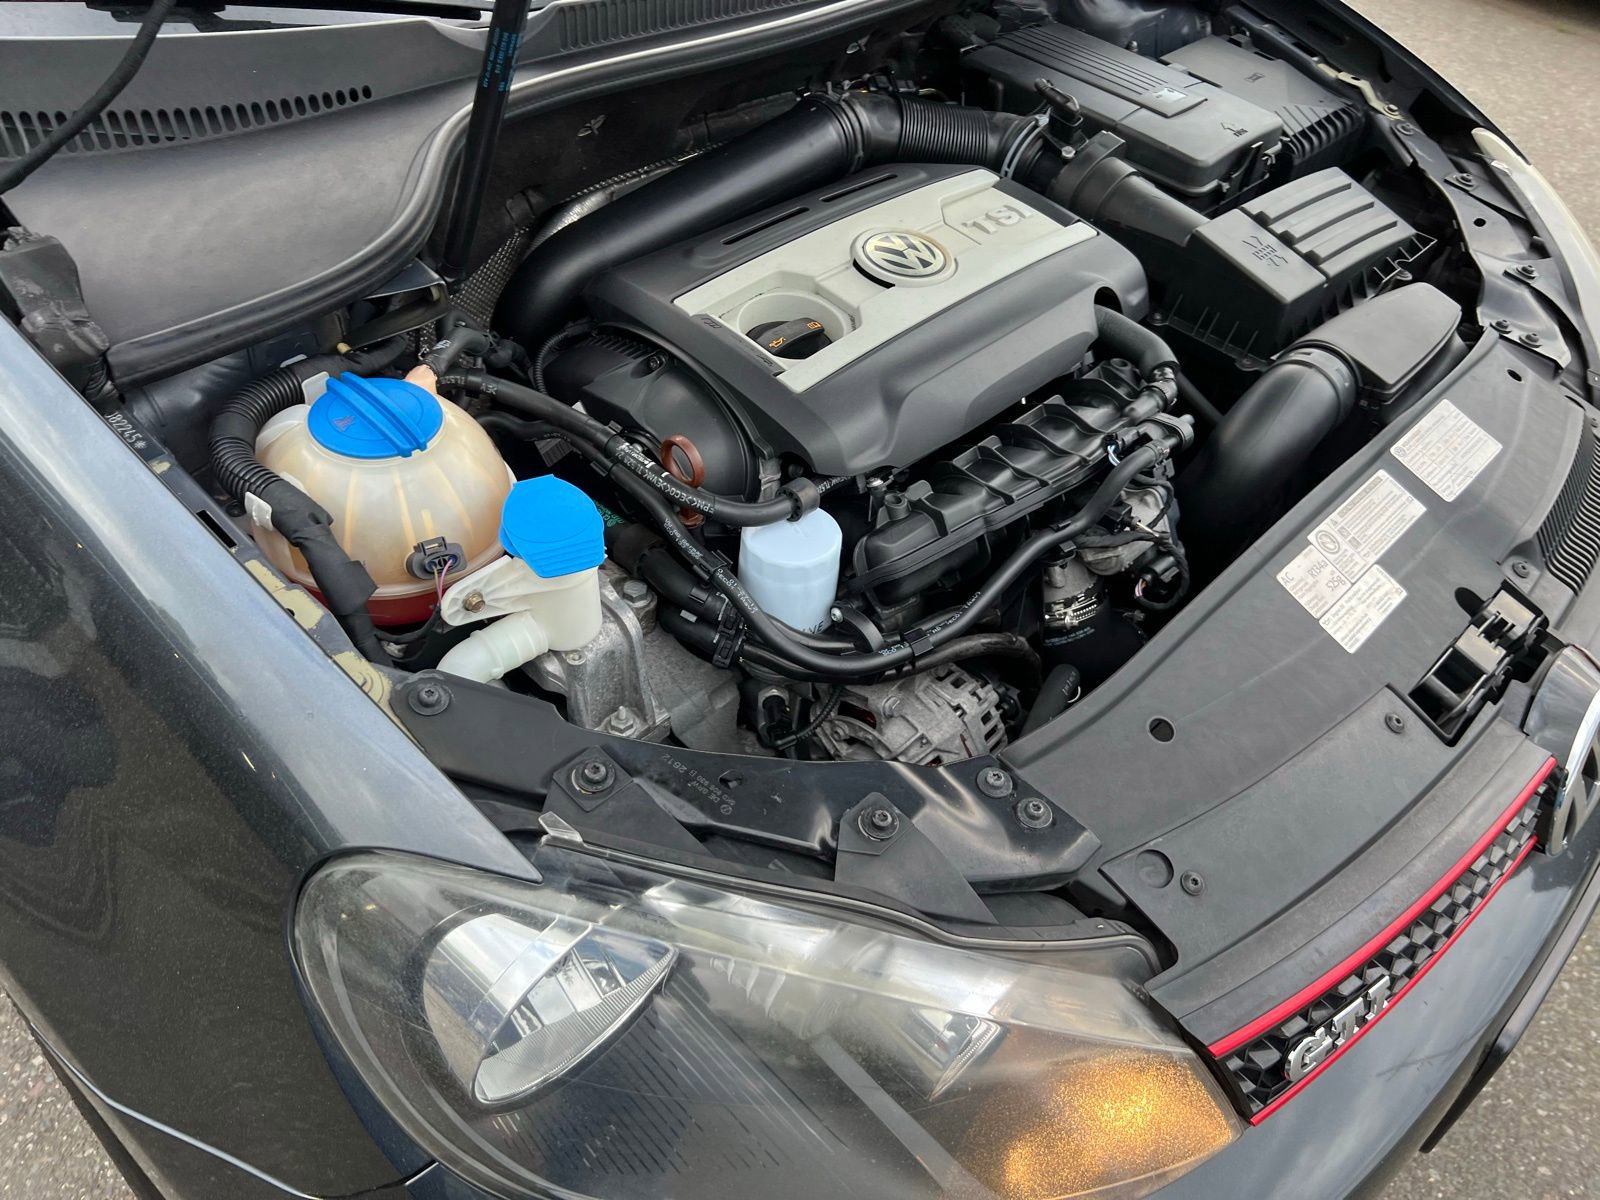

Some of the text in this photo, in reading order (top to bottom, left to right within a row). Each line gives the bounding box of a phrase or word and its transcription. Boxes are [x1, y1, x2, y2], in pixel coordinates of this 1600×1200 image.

[962, 205, 1030, 235] TSI
[1279, 570, 1295, 586] AC
[1306, 557, 1329, 578] R134a
[1285, 975, 1391, 1081] GTI
